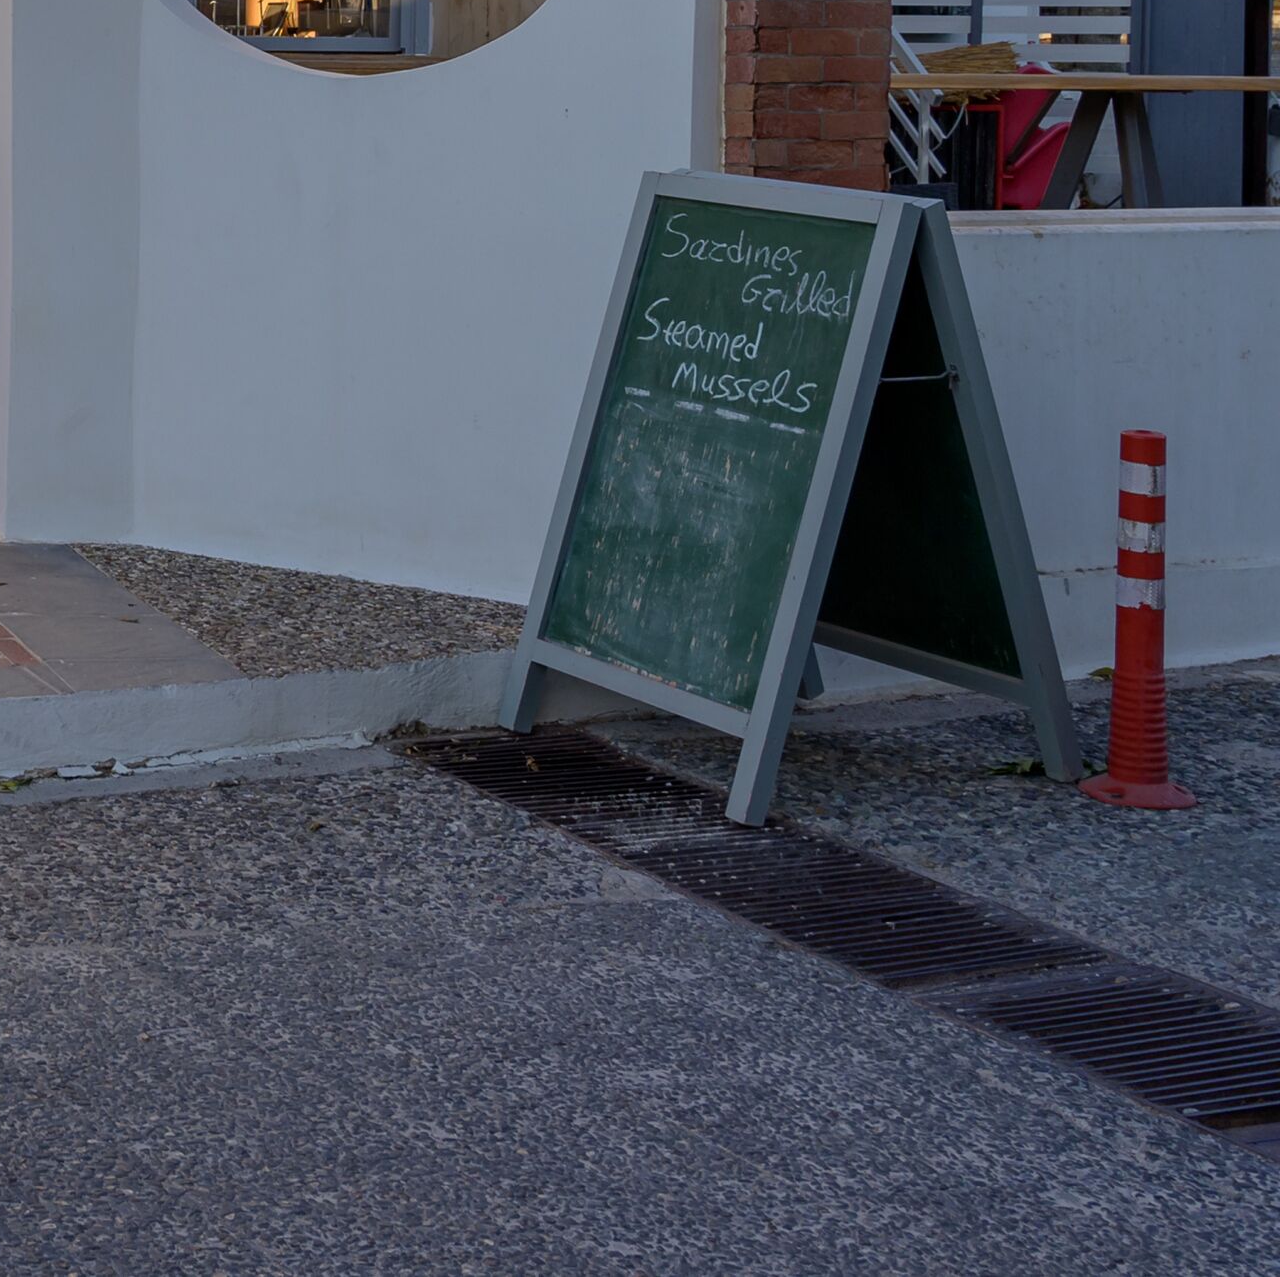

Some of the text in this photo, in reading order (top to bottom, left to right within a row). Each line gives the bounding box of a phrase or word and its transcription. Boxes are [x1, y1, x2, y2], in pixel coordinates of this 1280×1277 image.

[660, 213, 803, 276] Sardines
[741, 270, 856, 318] Grilled
[636, 297, 764, 362] Steamed
[671, 362, 818, 413] Mussels
